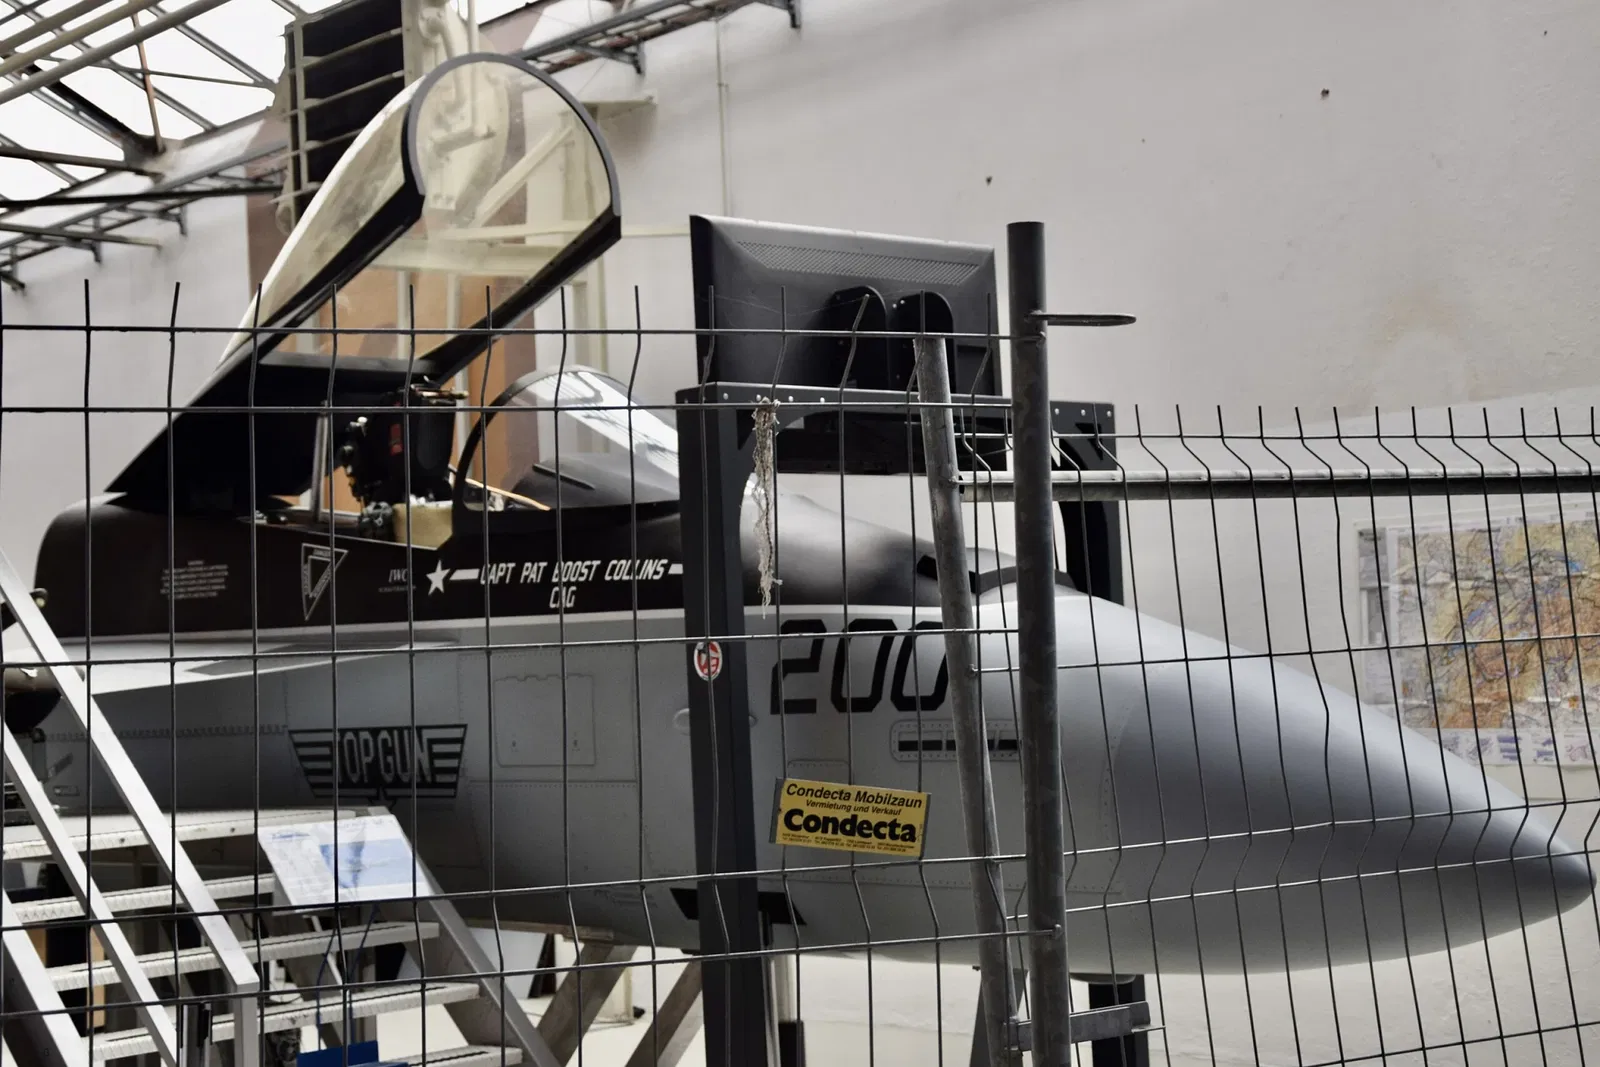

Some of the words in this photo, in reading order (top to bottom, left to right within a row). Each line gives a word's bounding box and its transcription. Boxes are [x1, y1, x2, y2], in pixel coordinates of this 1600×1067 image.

[520, 561, 548, 584] PAT
[552, 560, 601, 582] BOOST
[604, 559, 668, 581] COLLINS
[770, 618, 949, 715] 200
[786, 783, 851, 801] Condecta
[854, 790, 922, 808] Mobilzaun
[806, 799, 852, 813] Vermietung
[853, 805, 870, 813] und
[871, 807, 902, 815] Verkauf
[783, 808, 917, 843] Condecta
